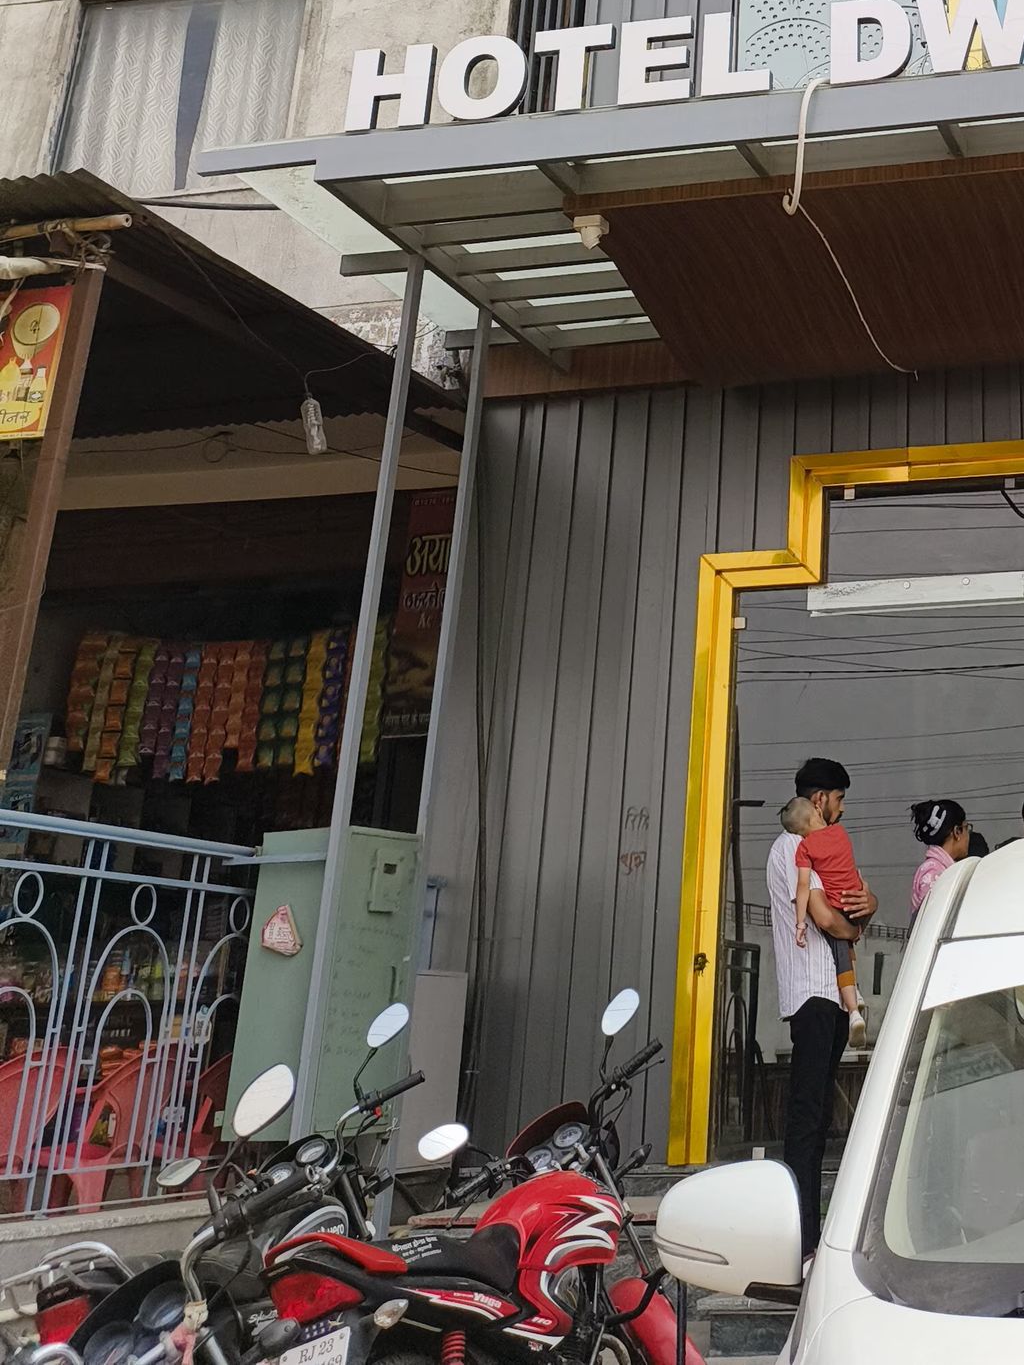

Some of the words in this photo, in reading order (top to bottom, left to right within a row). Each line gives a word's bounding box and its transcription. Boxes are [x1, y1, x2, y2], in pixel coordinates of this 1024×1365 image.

[345, 12, 773, 132] HOTEL
[298, 1344, 316, 1364] RJ
[318, 1338, 334, 1356] 23
